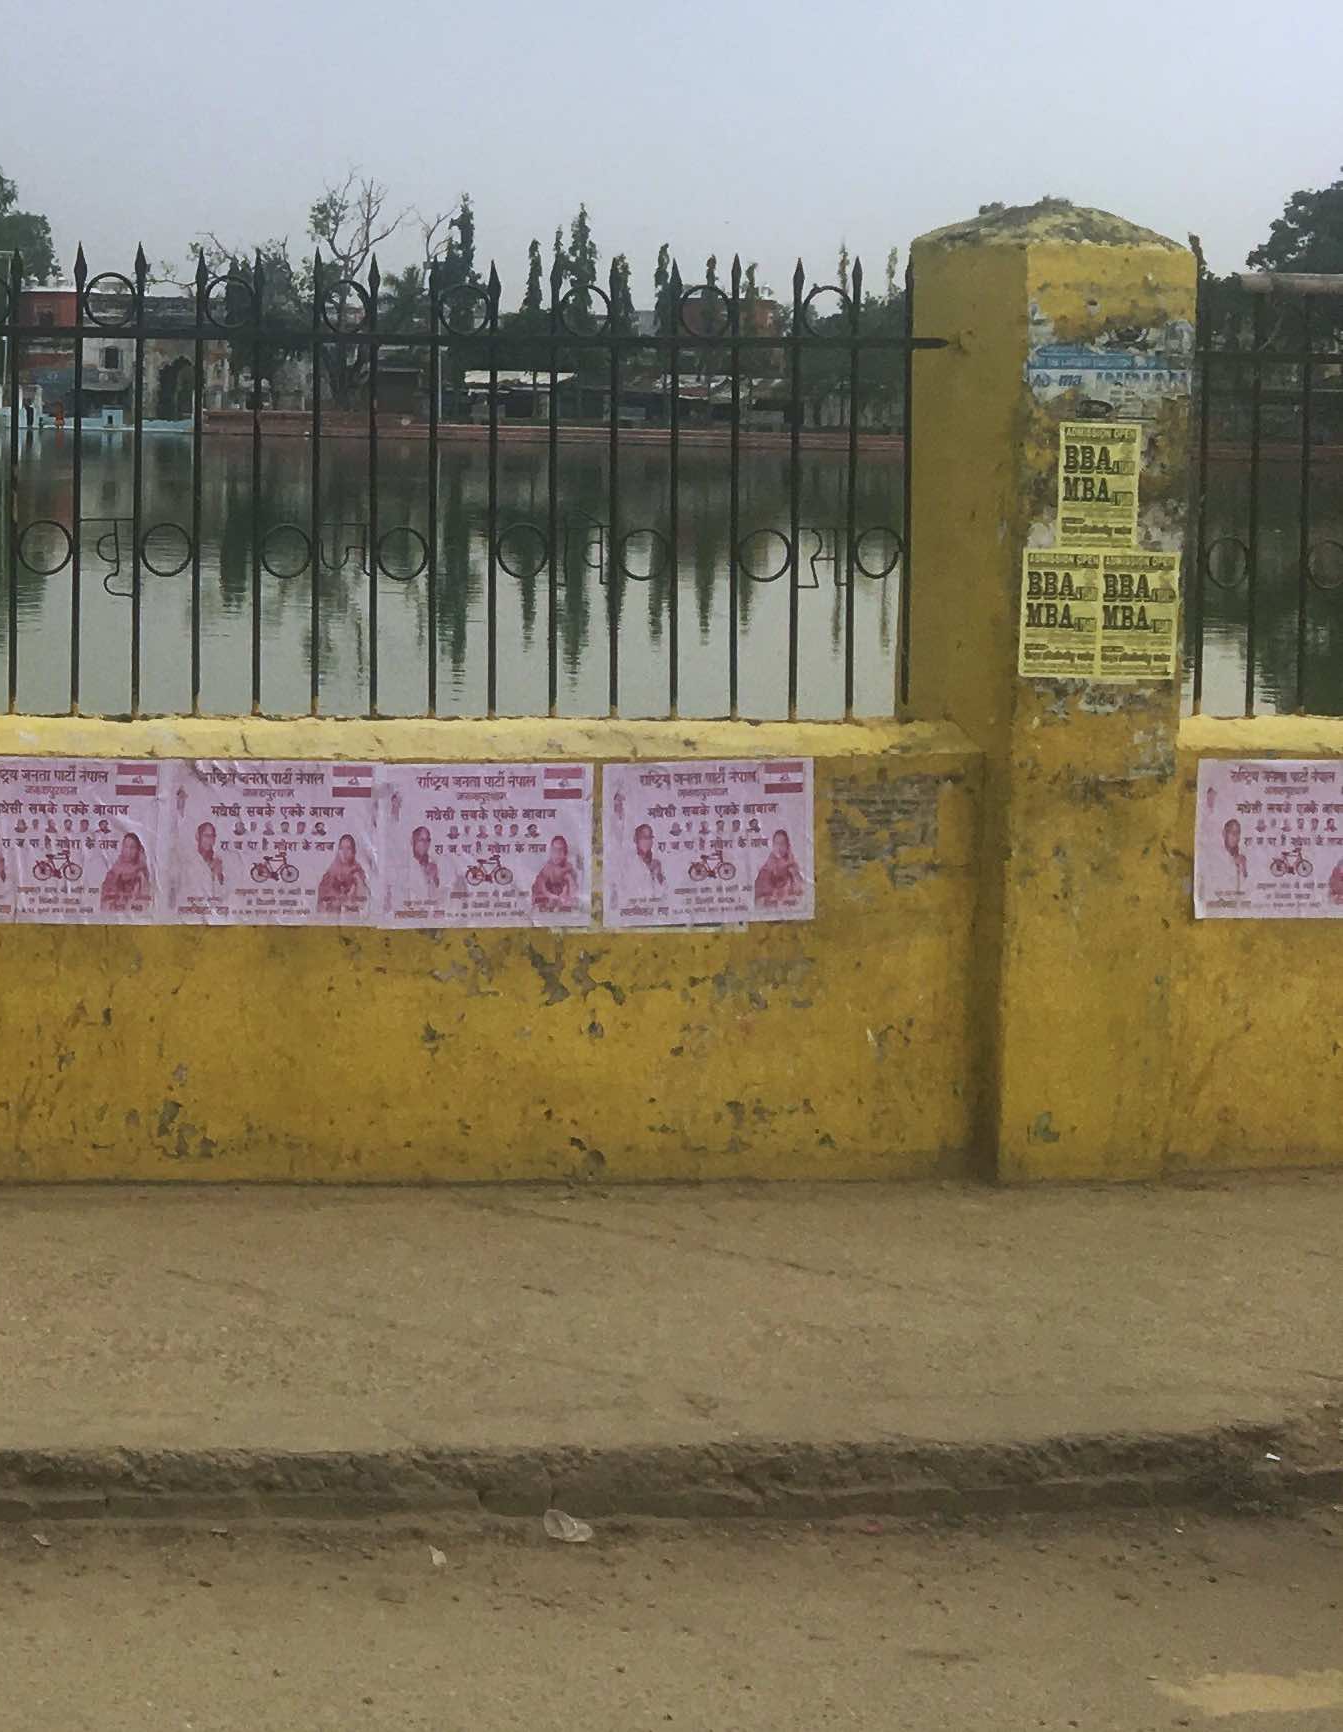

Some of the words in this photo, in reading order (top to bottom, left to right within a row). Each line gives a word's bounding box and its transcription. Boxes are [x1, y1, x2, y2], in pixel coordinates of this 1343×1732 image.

[1065, 427, 1111, 437] ADMISSION
[1114, 428, 1137, 438] OPEN
[1064, 445, 1112, 474] BBA
[1062, 477, 1110, 502] MBA
[1027, 571, 1076, 600] BBA
[1103, 573, 1152, 602] BBA
[1026, 603, 1074, 629] MBA
[1102, 605, 1151, 631] MBA
